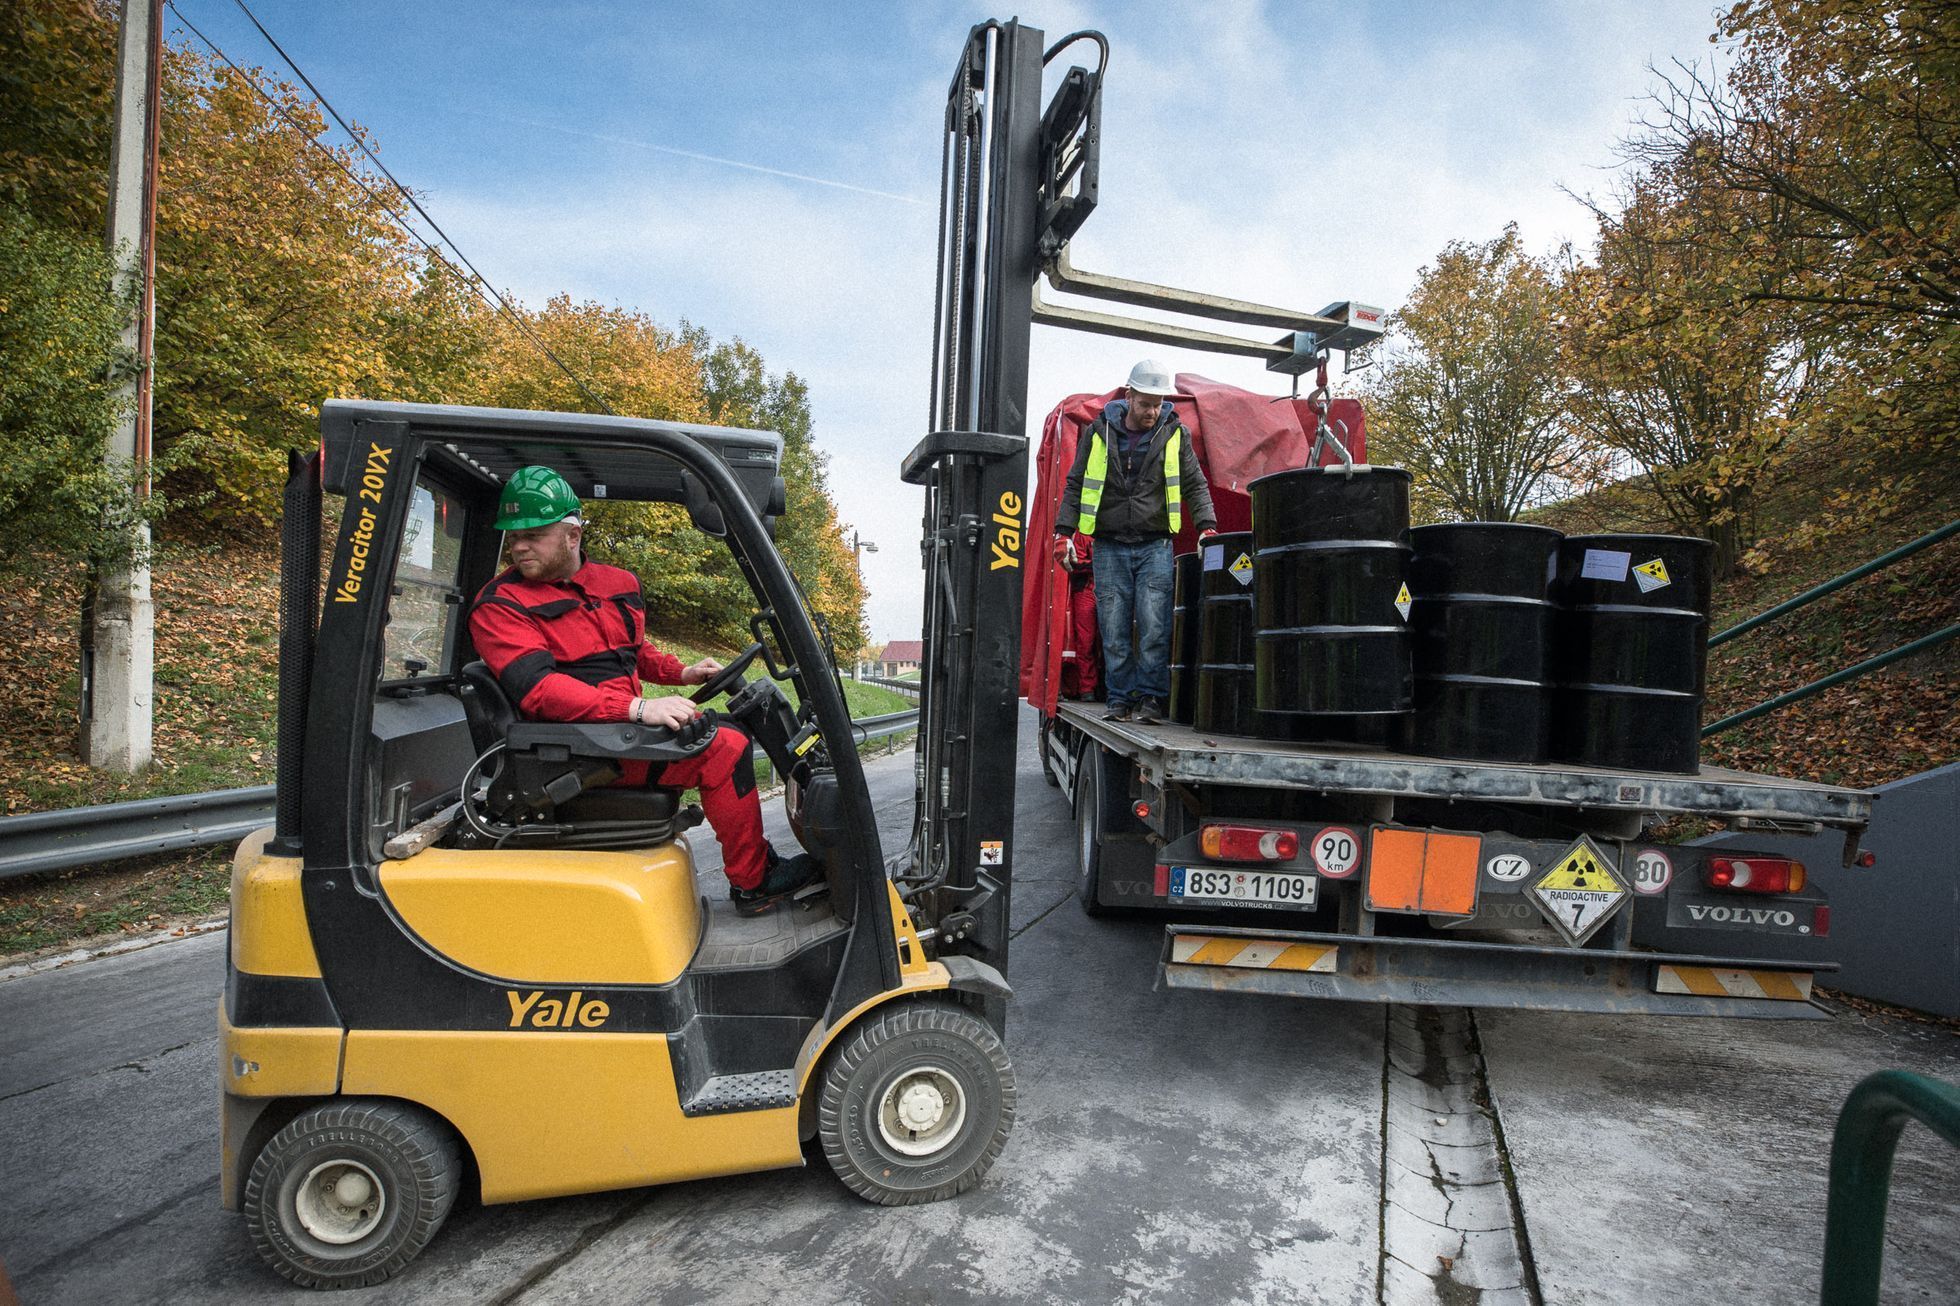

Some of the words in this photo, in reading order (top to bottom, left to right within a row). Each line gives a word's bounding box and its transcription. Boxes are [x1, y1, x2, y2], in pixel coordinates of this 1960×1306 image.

[335, 507, 377, 603] Veracitor
[359, 442, 393, 504] 20VX
[990, 491, 1022, 571] Yale
[1322, 838, 1351, 861] 90
[1327, 861, 1344, 871] km
[1492, 859, 1523, 877] CZ
[1172, 886, 1184, 894] CZ
[1190, 872, 1231, 895] 8S3
[1251, 875, 1305, 900] 1109
[1550, 891, 1609, 903] RADIOACTIVE
[1571, 904, 1586, 928] 7
[1686, 905, 1795, 926] VOLVO
[507, 991, 611, 1028] Yale
